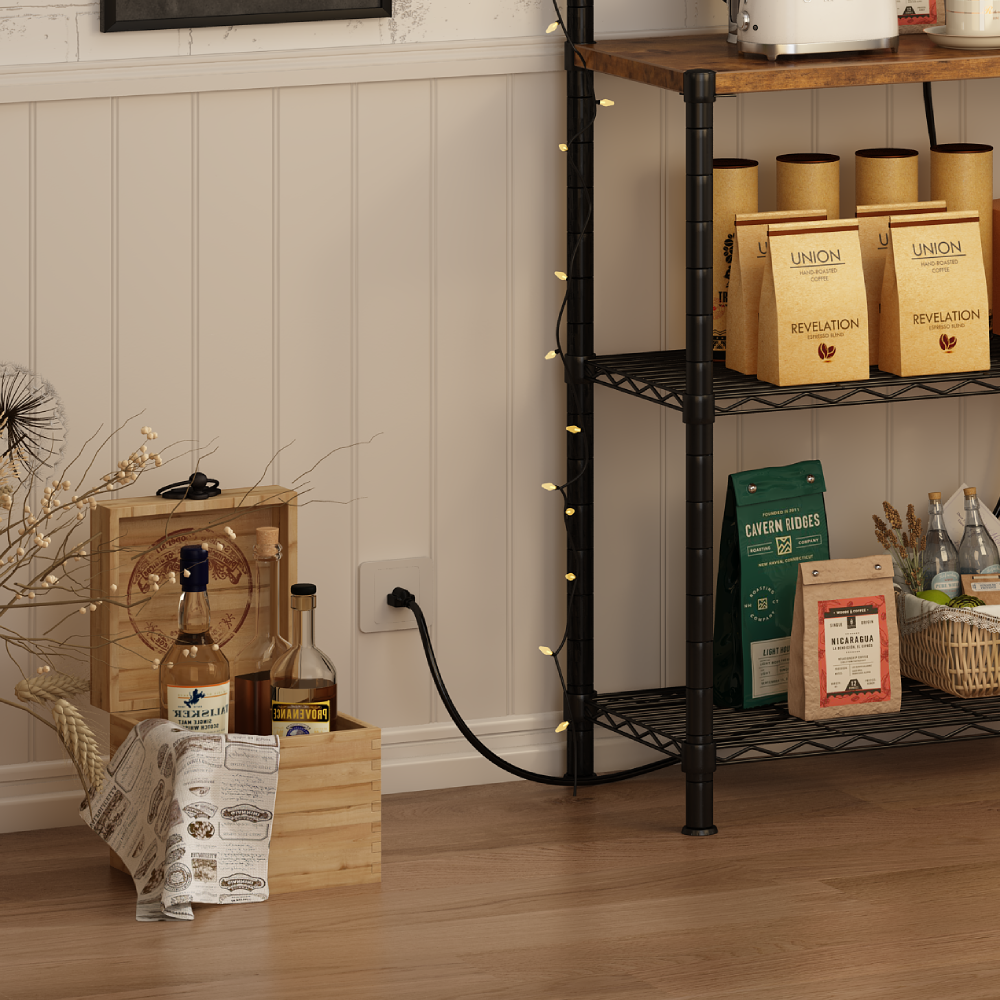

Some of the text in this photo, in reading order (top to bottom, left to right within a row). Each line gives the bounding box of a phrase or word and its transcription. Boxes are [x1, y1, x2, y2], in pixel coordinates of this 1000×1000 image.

[912, 240, 962, 256] UNION
[791, 249, 841, 265] UNION
[913, 309, 980, 325] REVELATION
[791, 318, 859, 334] REVELATION
[745, 513, 820, 537] CAVERN RIDGES
[832, 635, 874, 645] NICARAGUA
[763, 647, 779, 656] LIGHT
